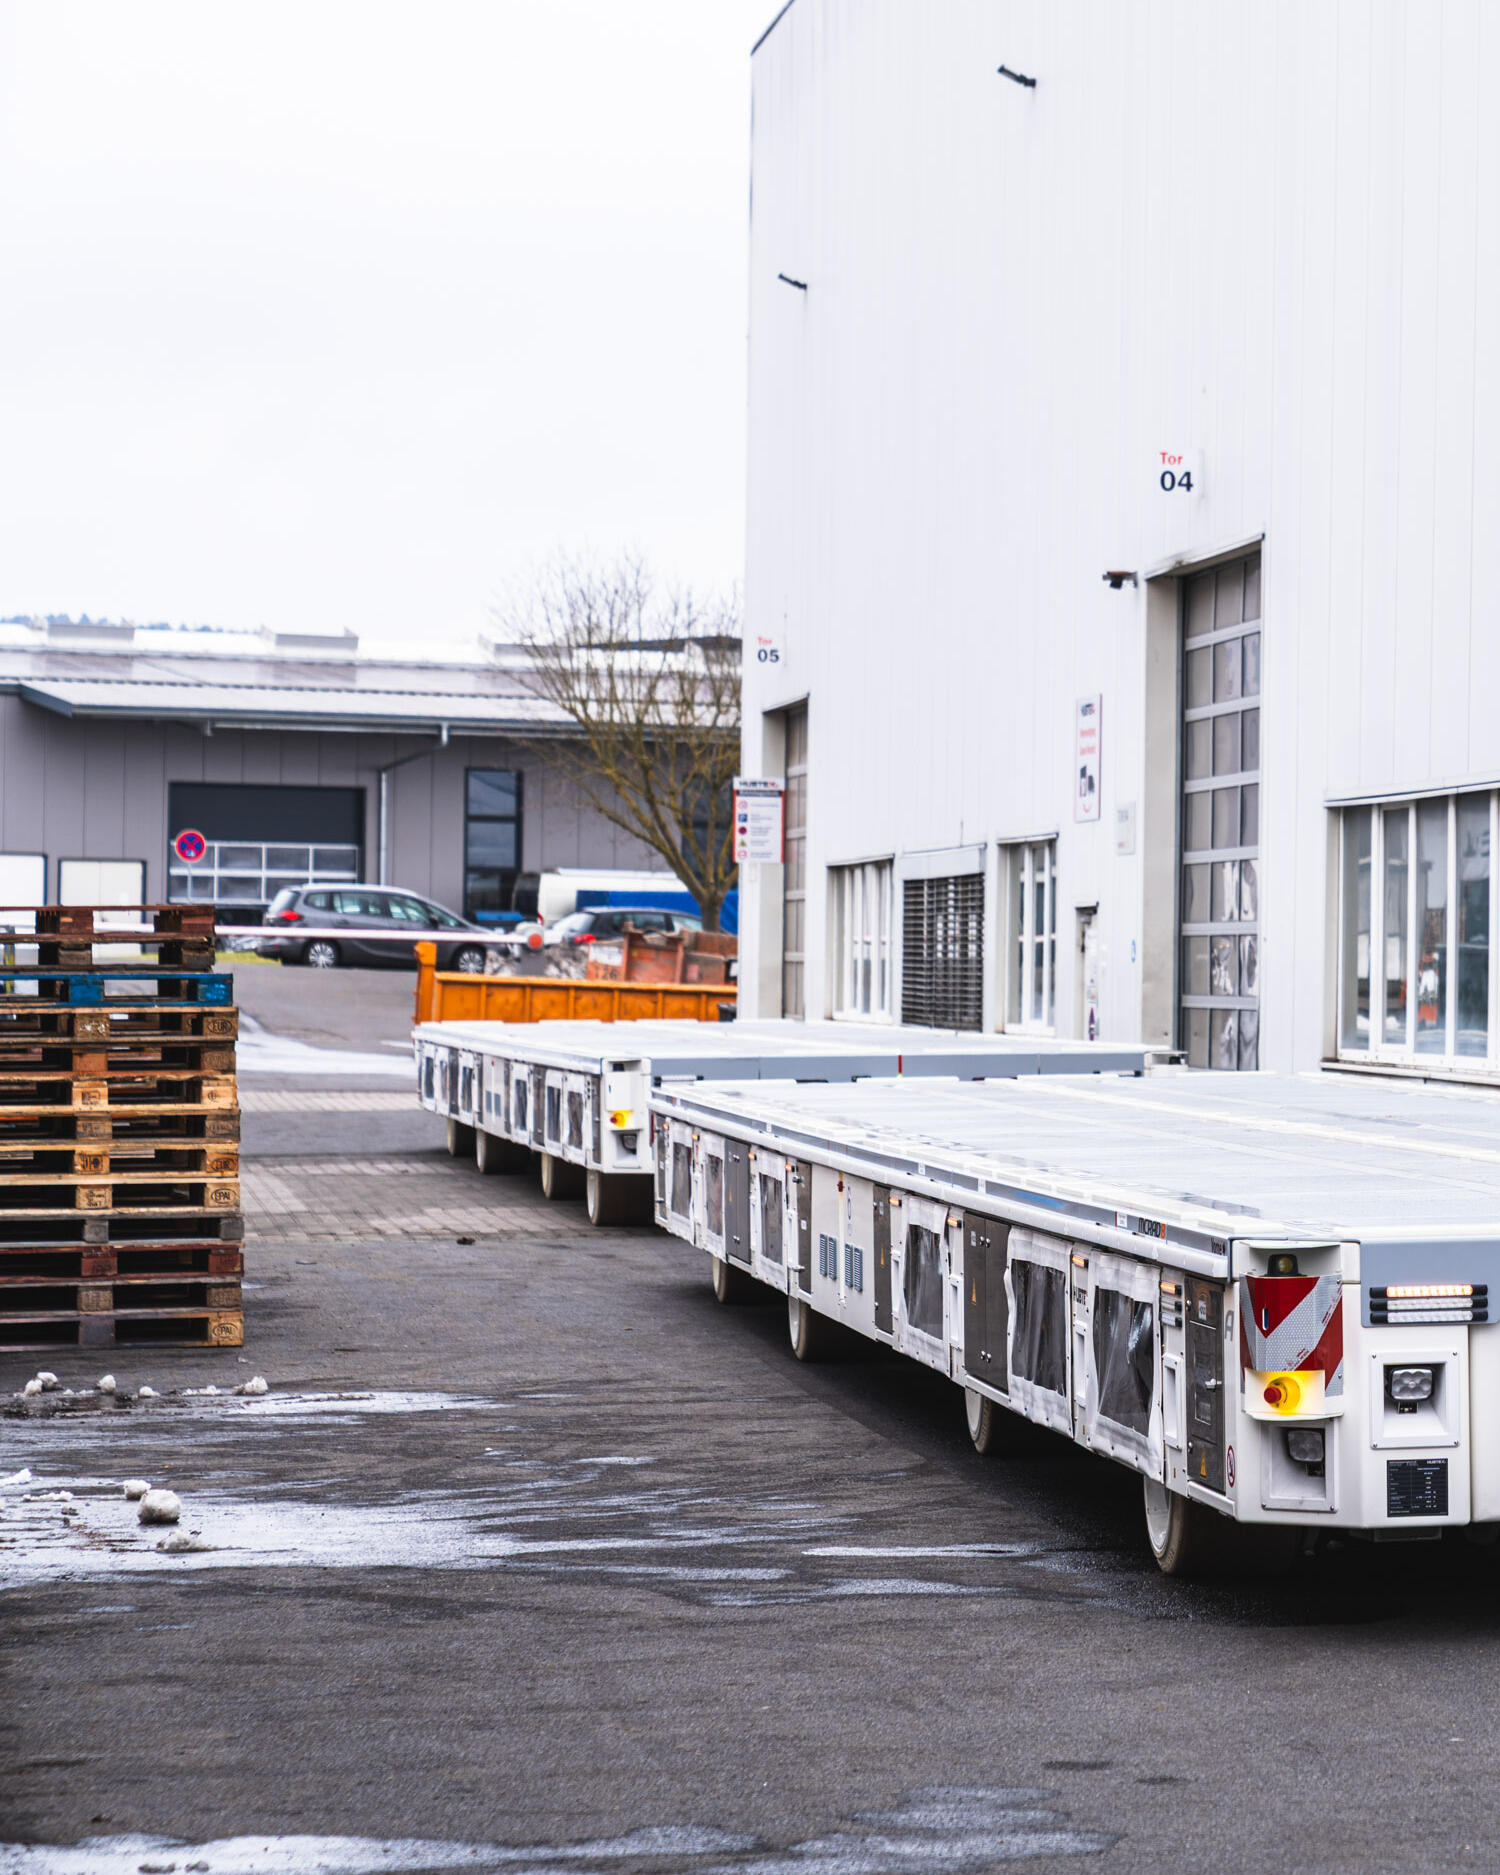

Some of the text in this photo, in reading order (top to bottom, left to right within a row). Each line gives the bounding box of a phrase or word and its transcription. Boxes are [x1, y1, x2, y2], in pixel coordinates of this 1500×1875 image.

[1160, 452, 1184, 465] Tor
[1160, 470, 1194, 492] 04
[758, 649, 779, 663] 05
